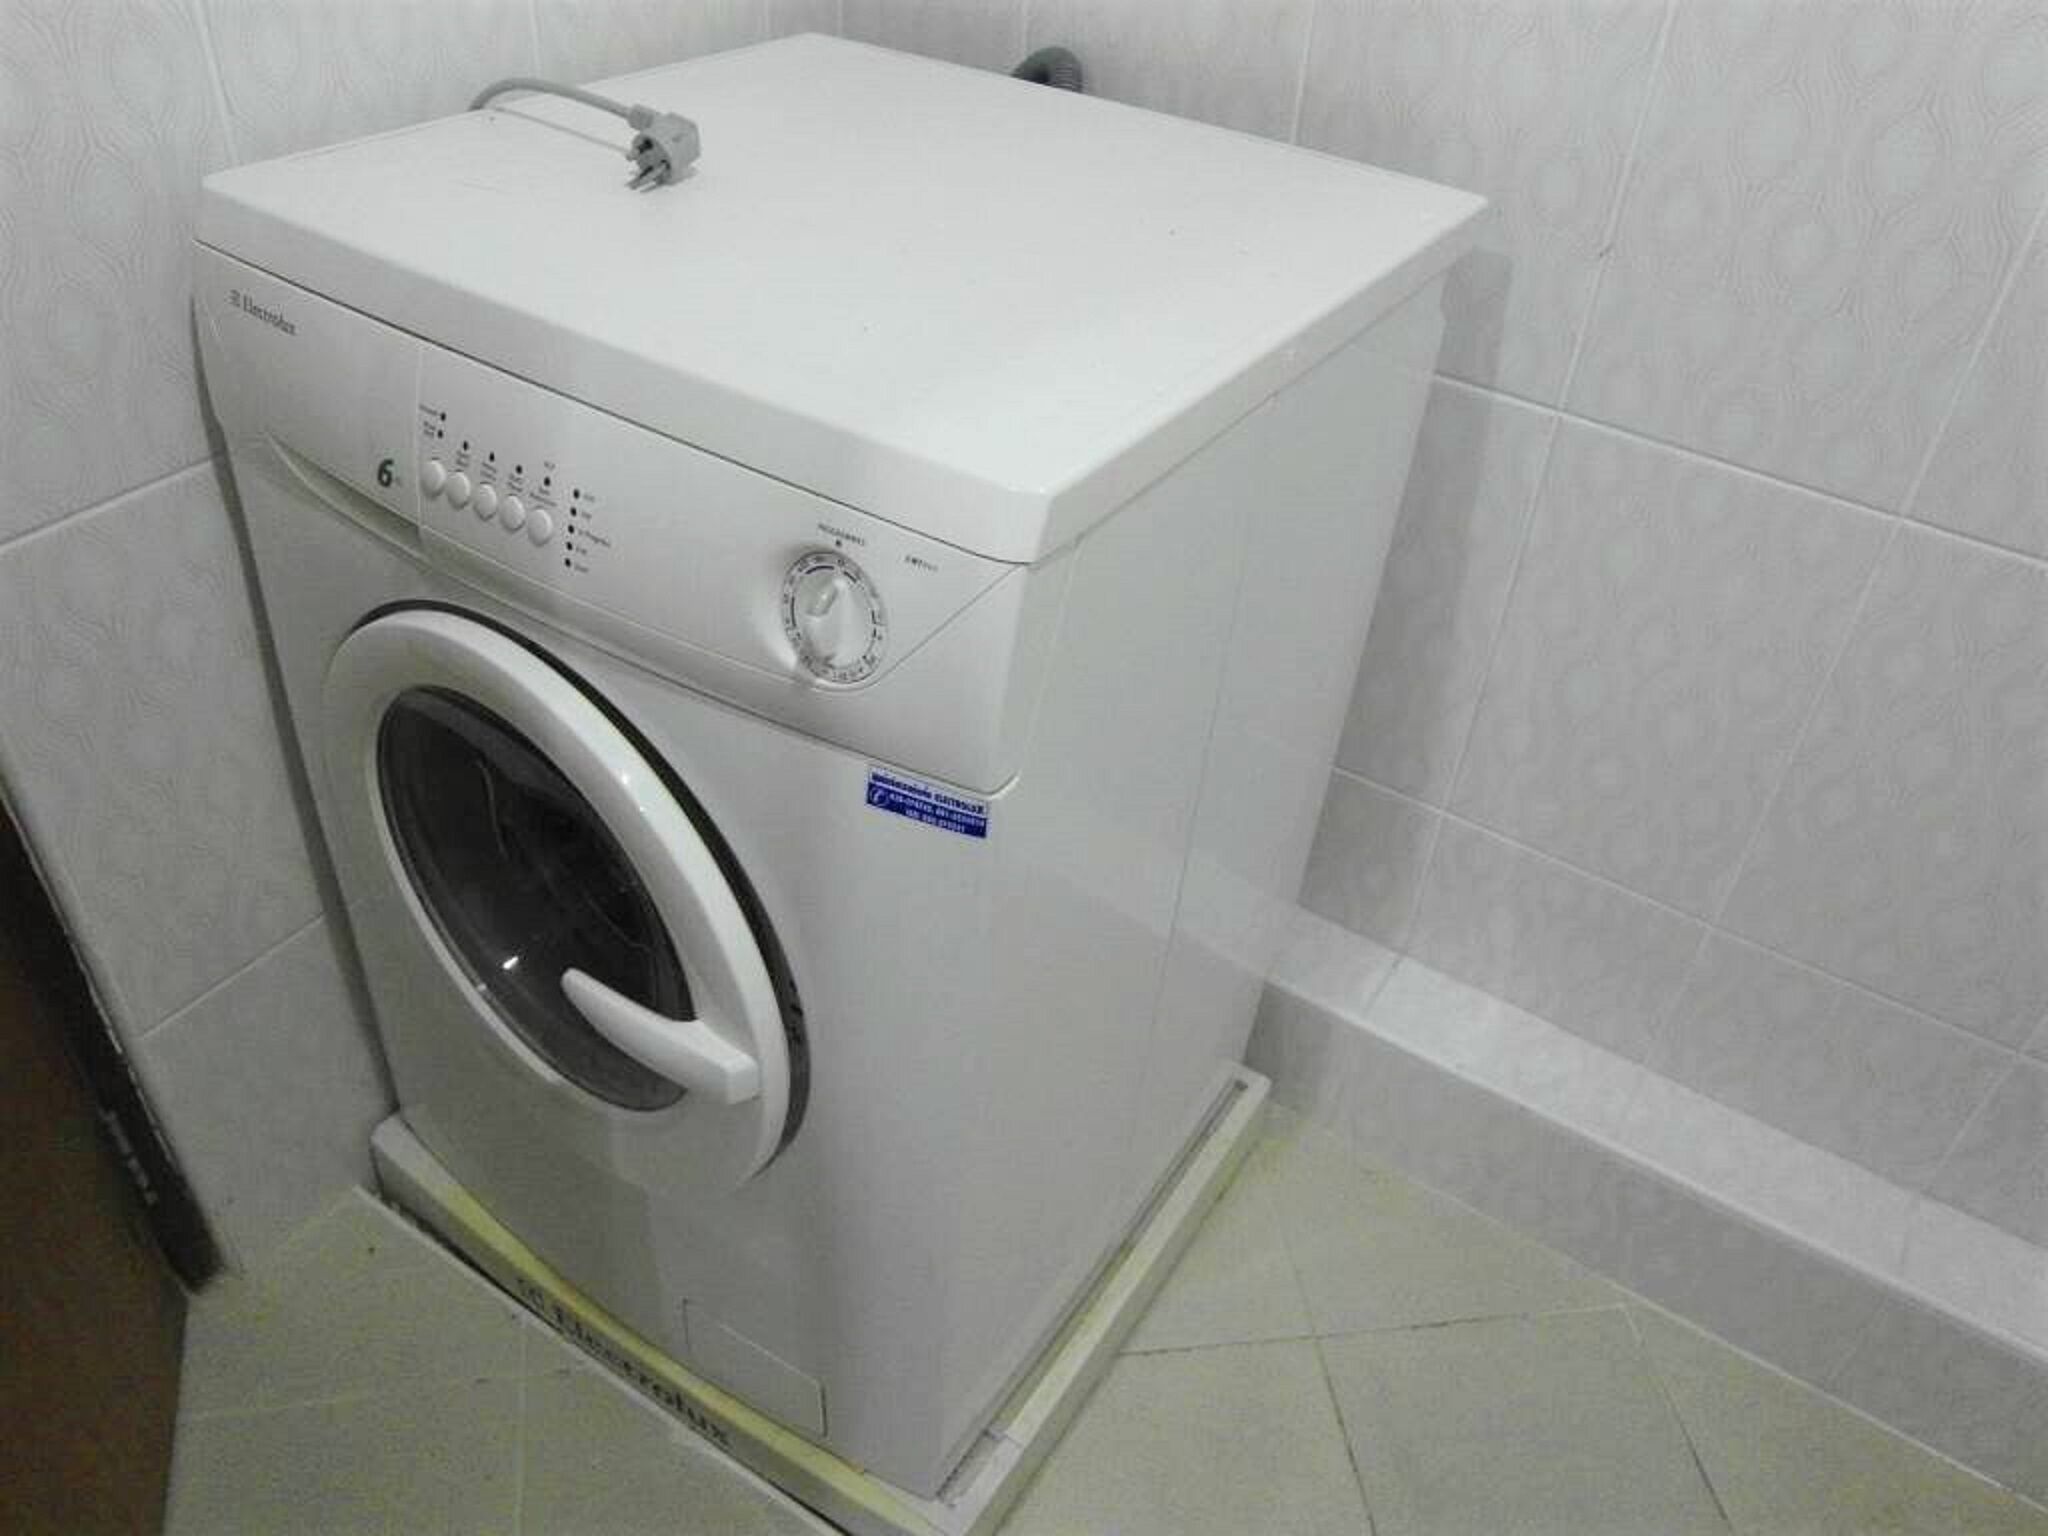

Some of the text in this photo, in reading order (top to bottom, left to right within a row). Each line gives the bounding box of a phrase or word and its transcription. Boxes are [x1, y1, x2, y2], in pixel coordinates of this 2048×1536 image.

[243, 292, 296, 337] Electrolux
[377, 458, 394, 488] 6
[549, 1303, 729, 1448] Electrolux
